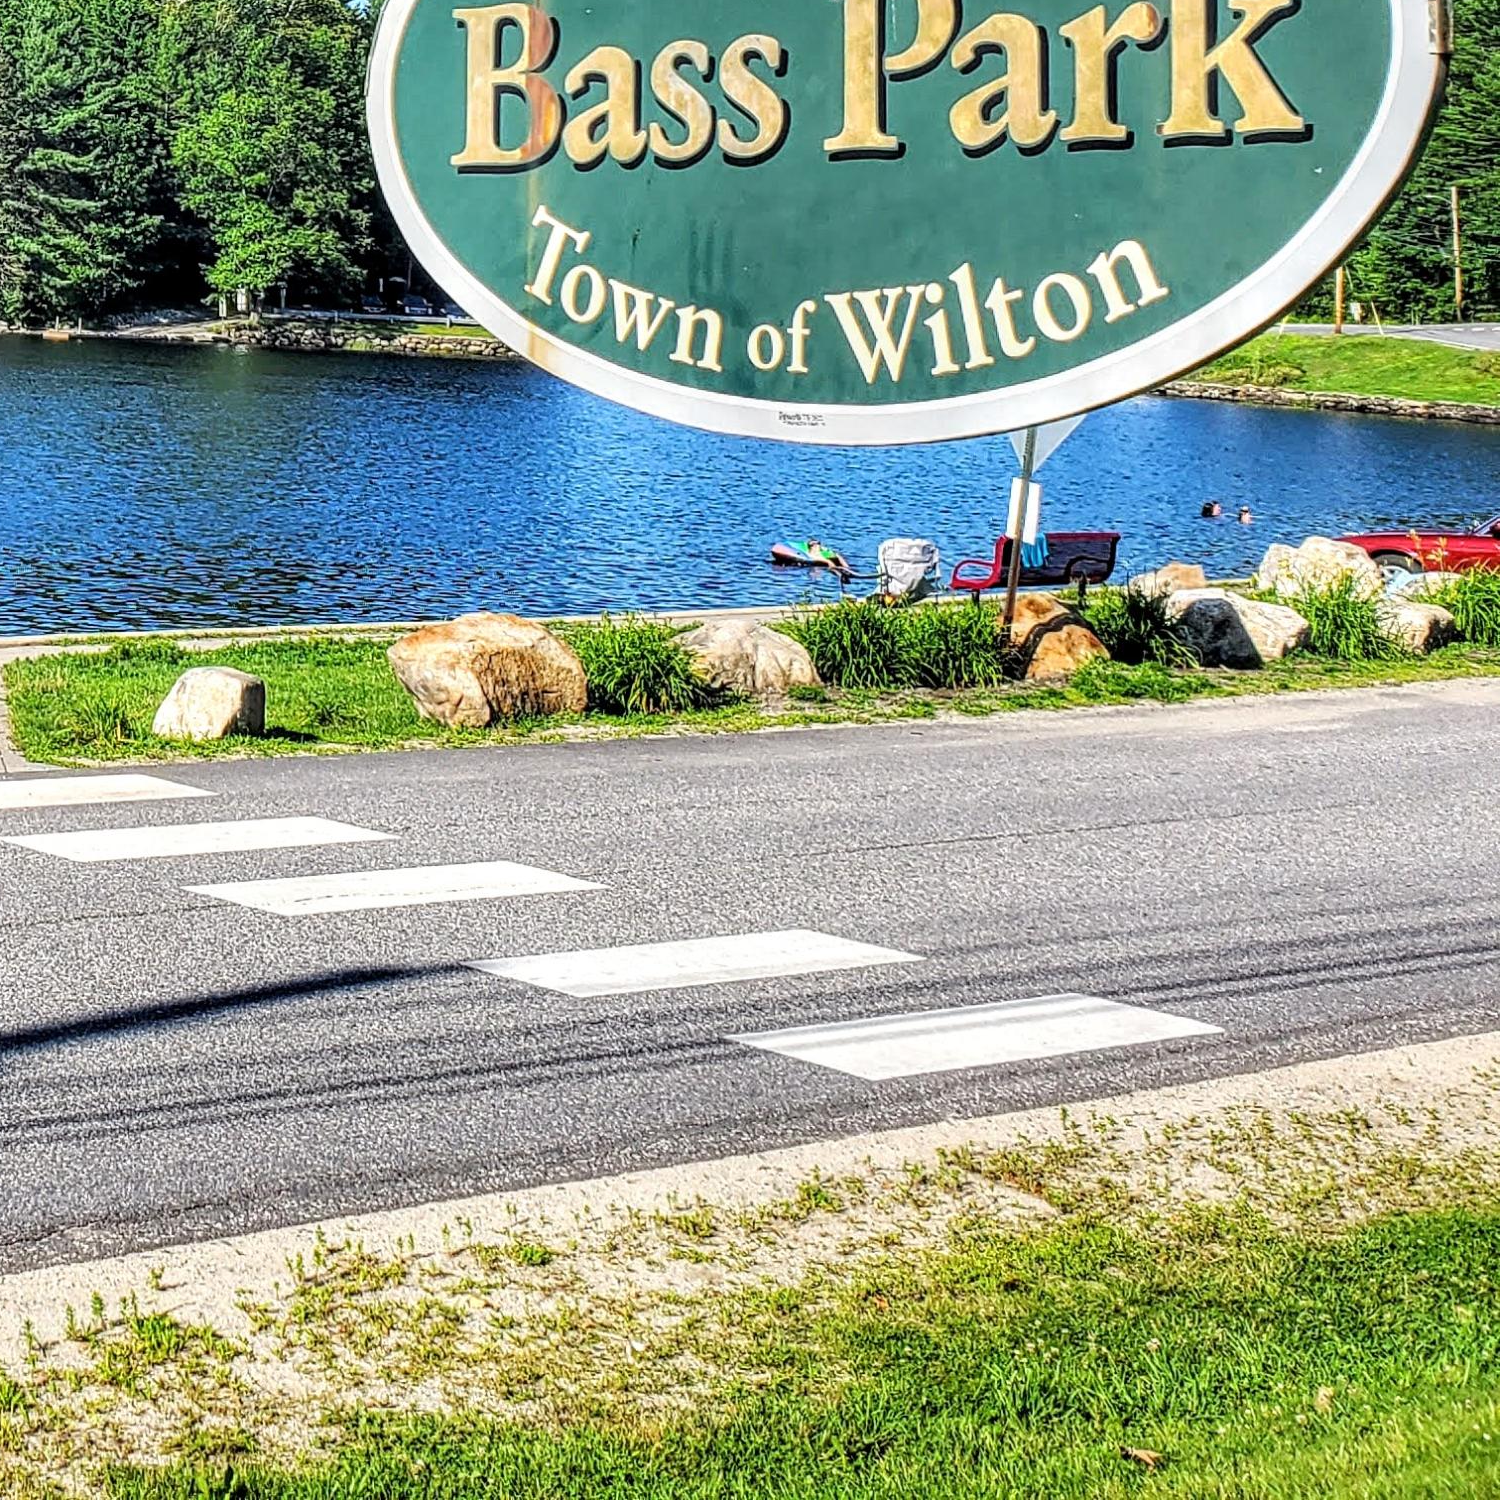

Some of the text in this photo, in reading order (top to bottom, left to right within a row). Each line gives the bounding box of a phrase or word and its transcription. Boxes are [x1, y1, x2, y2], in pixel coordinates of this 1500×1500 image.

[450, 1, 789, 171] Bass
[523, 204, 1169, 384] Town of Wilton
